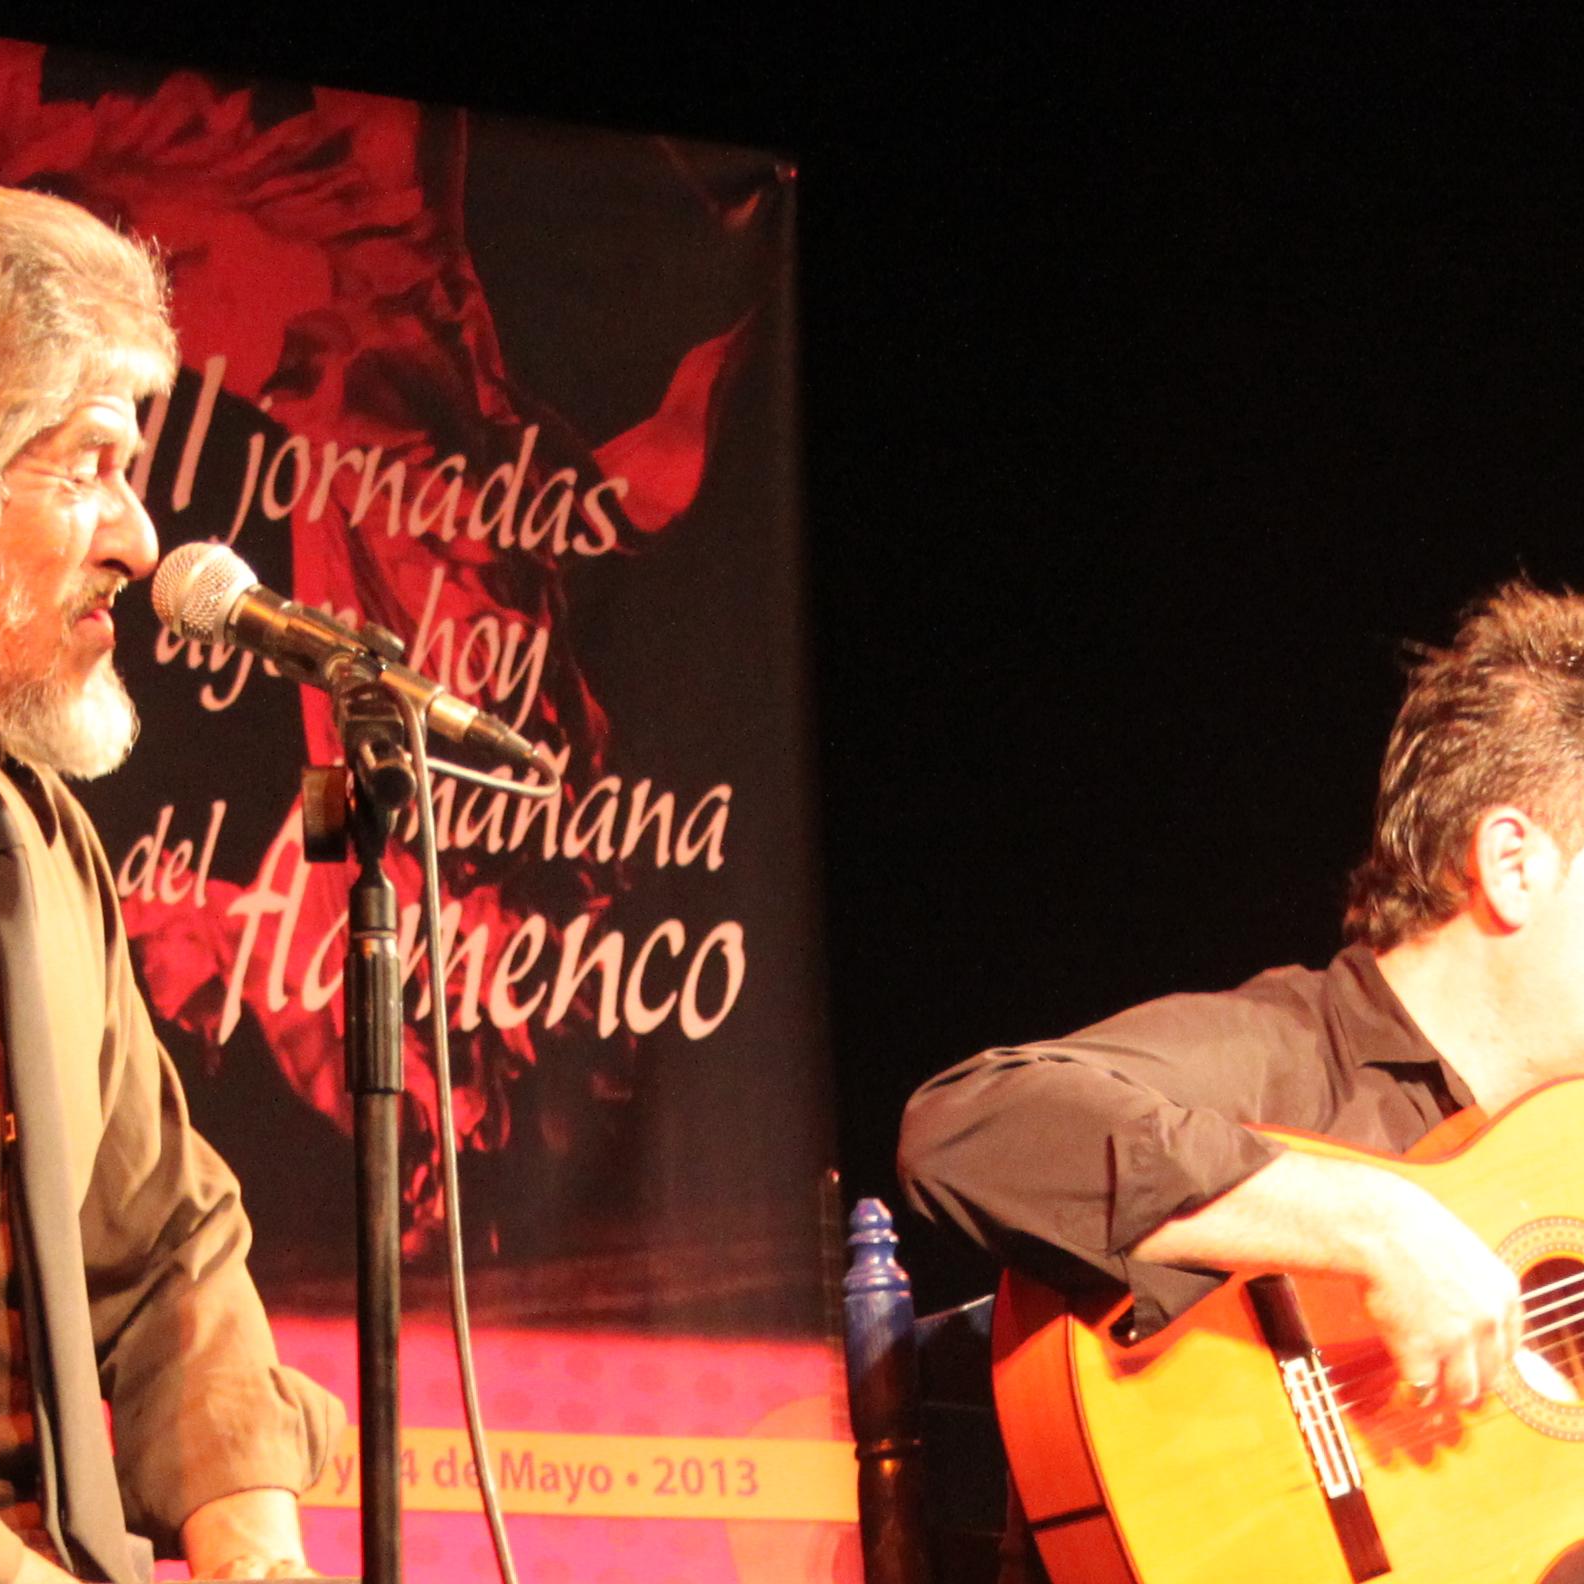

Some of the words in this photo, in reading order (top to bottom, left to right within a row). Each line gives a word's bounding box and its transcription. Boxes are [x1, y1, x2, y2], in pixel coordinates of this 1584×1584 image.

[209, 396, 629, 557] jornadas
[409, 565, 550, 736] hoy
[116, 799, 227, 908] del
[332, 1453, 354, 1496] y
[432, 1444, 482, 1489] de
[499, 1449, 614, 1504] Mayo
[652, 1456, 761, 1498] 2013
